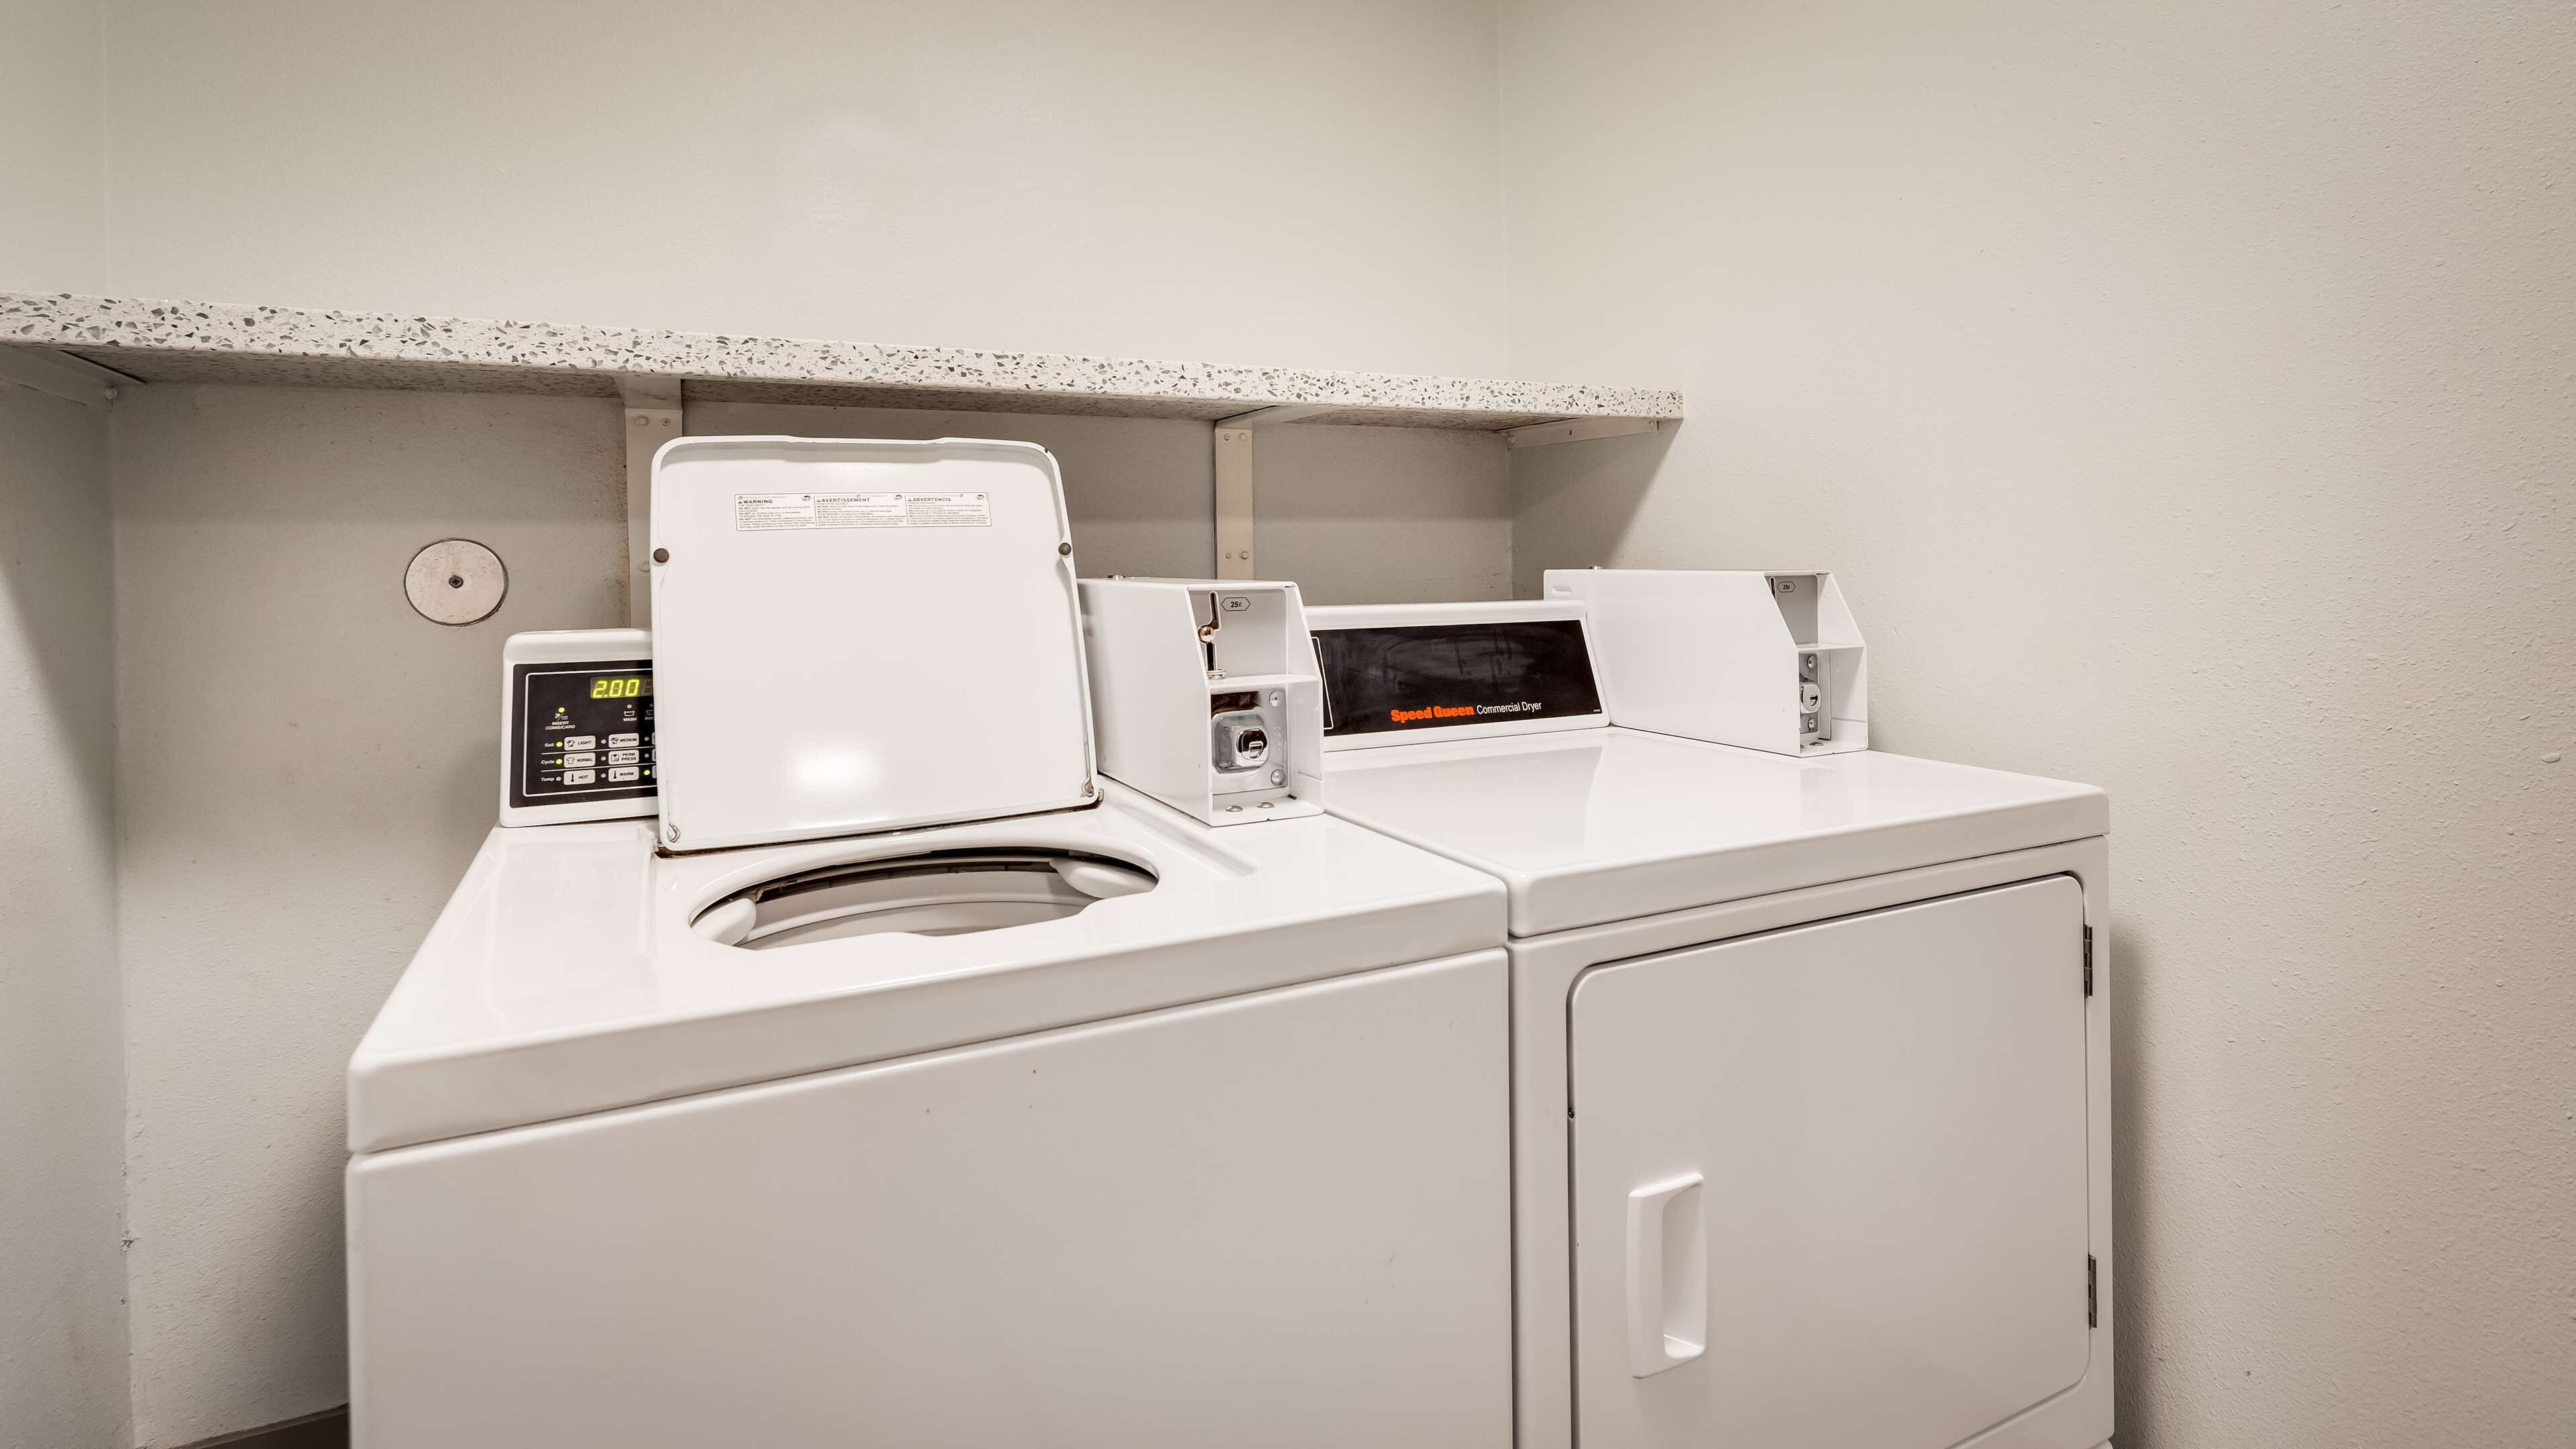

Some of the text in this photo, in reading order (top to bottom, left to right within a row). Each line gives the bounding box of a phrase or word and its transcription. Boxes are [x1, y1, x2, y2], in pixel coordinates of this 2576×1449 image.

[592, 679, 640, 698] 2.00
[1390, 701, 1542, 724] Speed Queen Commercial Dryer
